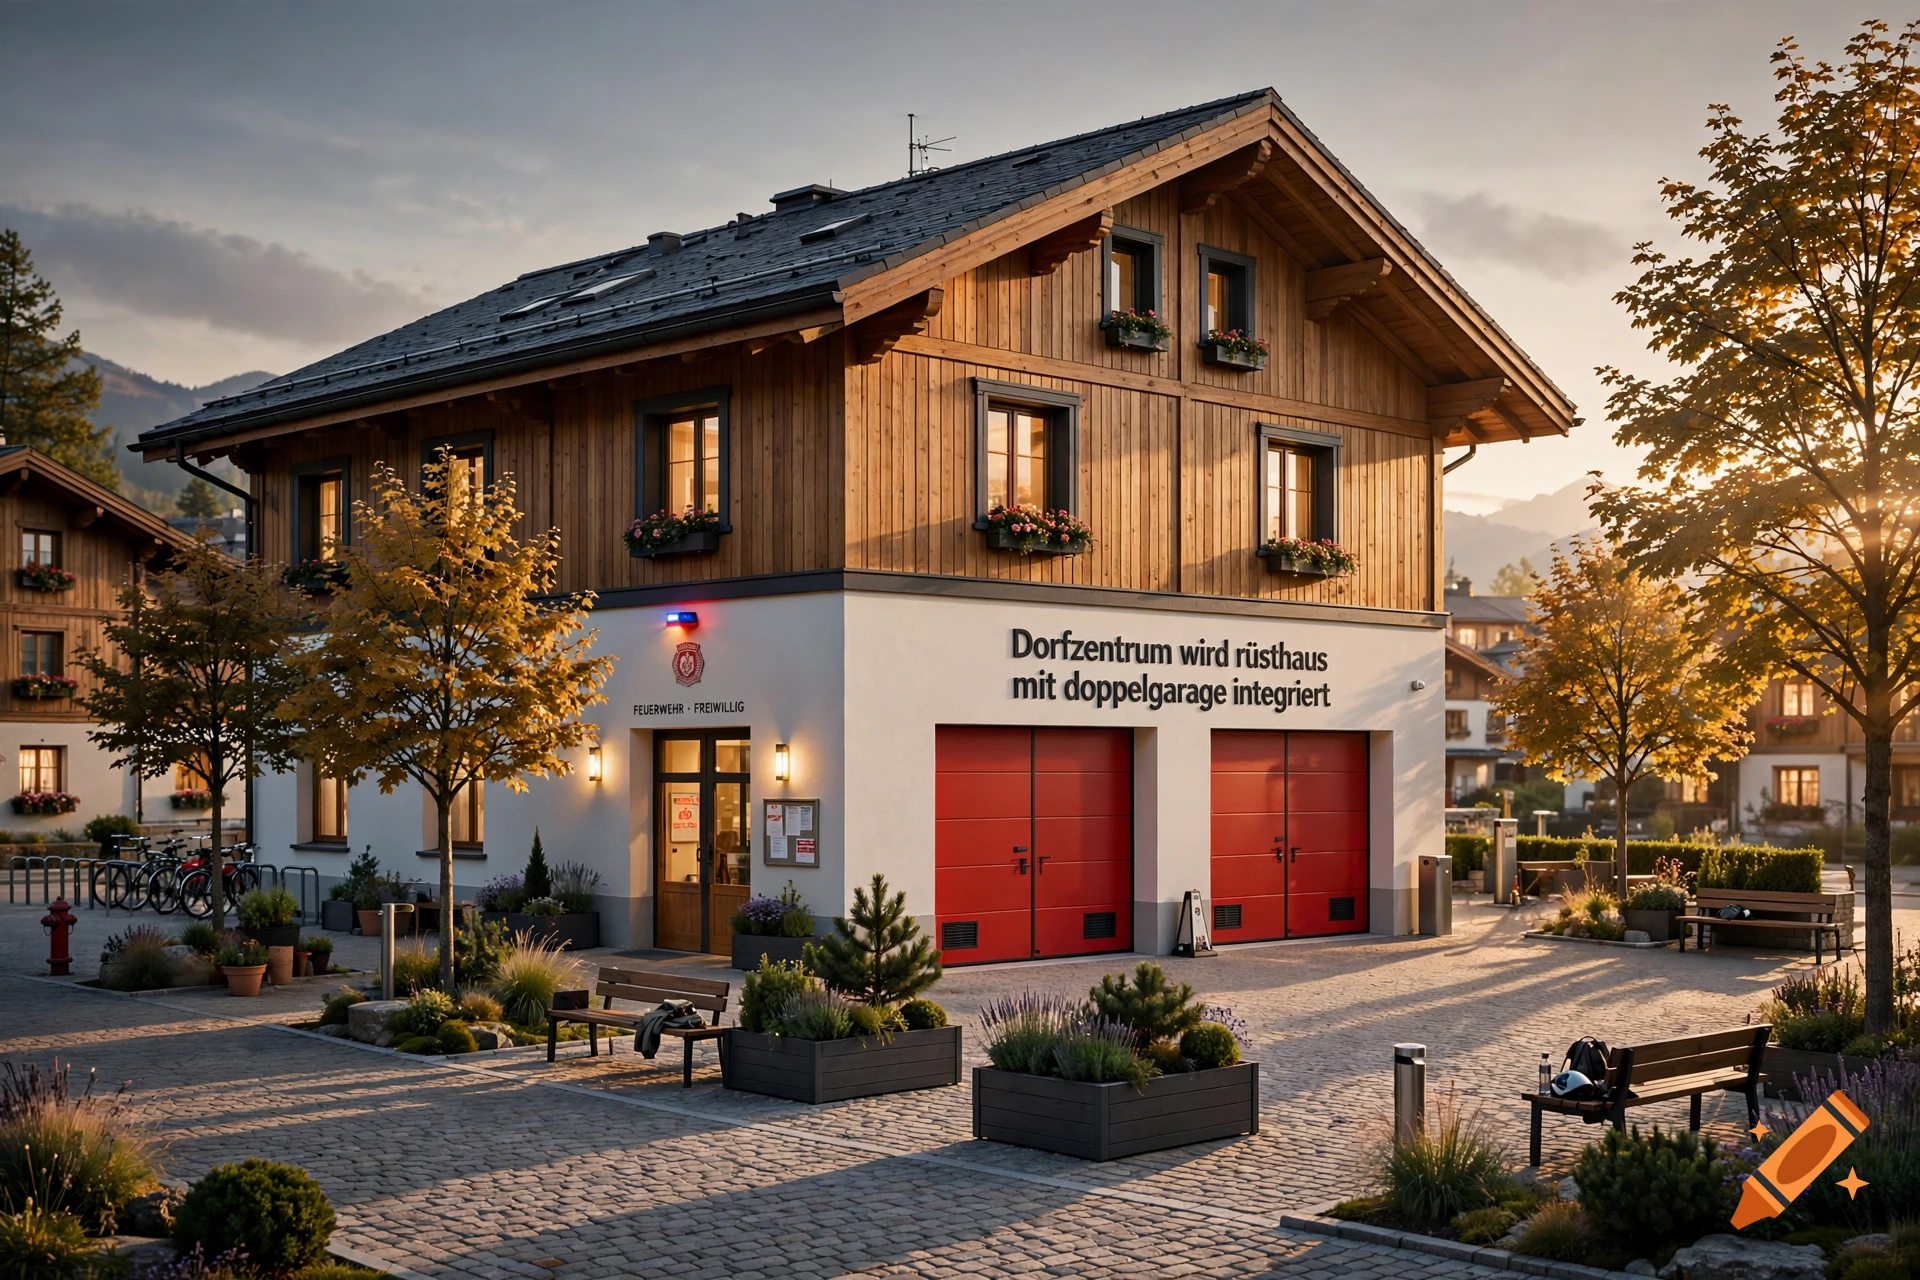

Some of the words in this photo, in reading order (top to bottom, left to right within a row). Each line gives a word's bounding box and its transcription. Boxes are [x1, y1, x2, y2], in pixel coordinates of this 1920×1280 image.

[1011, 628, 1173, 666] Dorfzentrum
[1179, 638, 1229, 668] wird
[1236, 641, 1328, 672] rüsthaus
[633, 703, 684, 715] FEUERWEHR
[694, 701, 744, 713] FREIWILLIG
[1013, 669, 1057, 700] mit
[1064, 670, 1227, 712] doppelgarage
[1233, 677, 1331, 714] integriert
